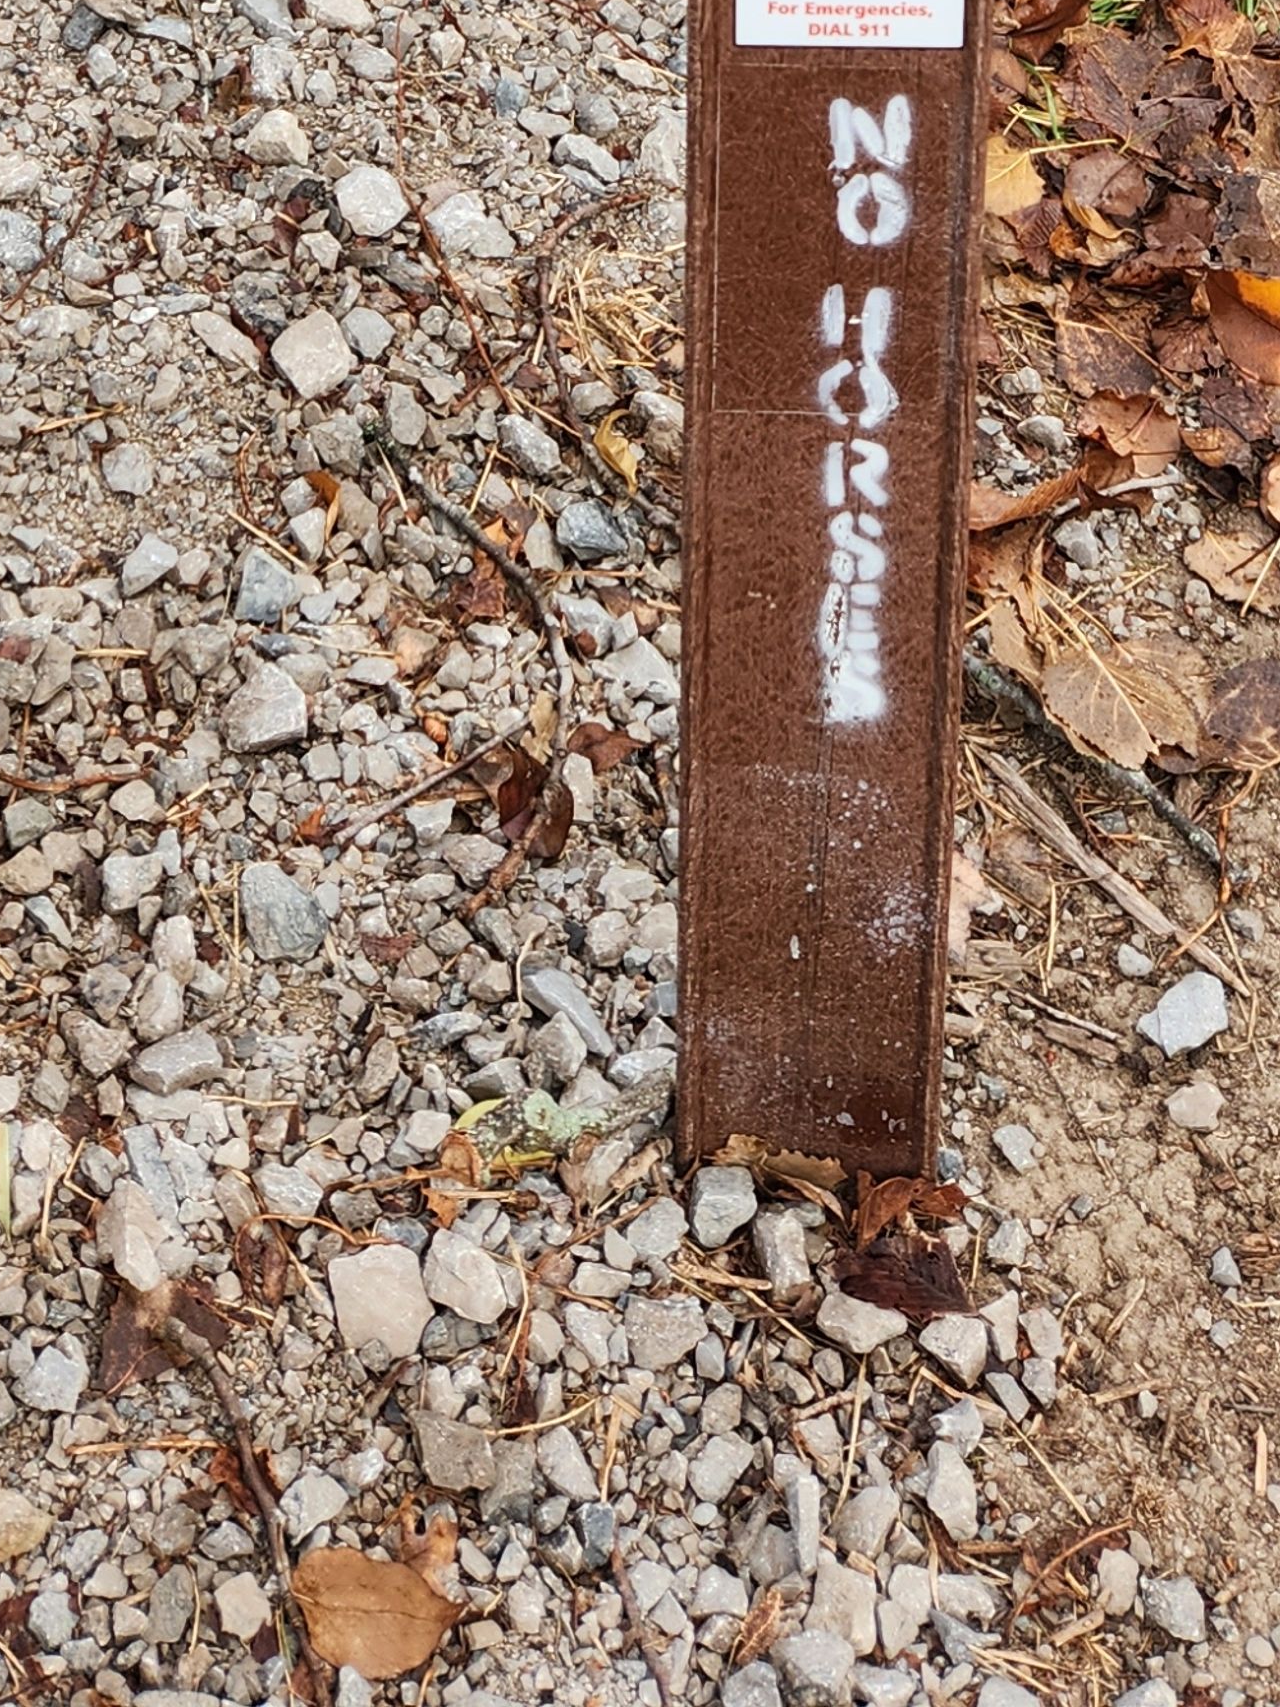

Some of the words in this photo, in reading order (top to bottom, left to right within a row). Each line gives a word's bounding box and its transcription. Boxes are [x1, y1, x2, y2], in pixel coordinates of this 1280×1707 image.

[768, 2, 798, 15] For
[805, 2, 933, 18] Emergencies,
[808, 23, 853, 36] DIAL
[859, 23, 890, 36] 911
[829, 94, 911, 246] NO
